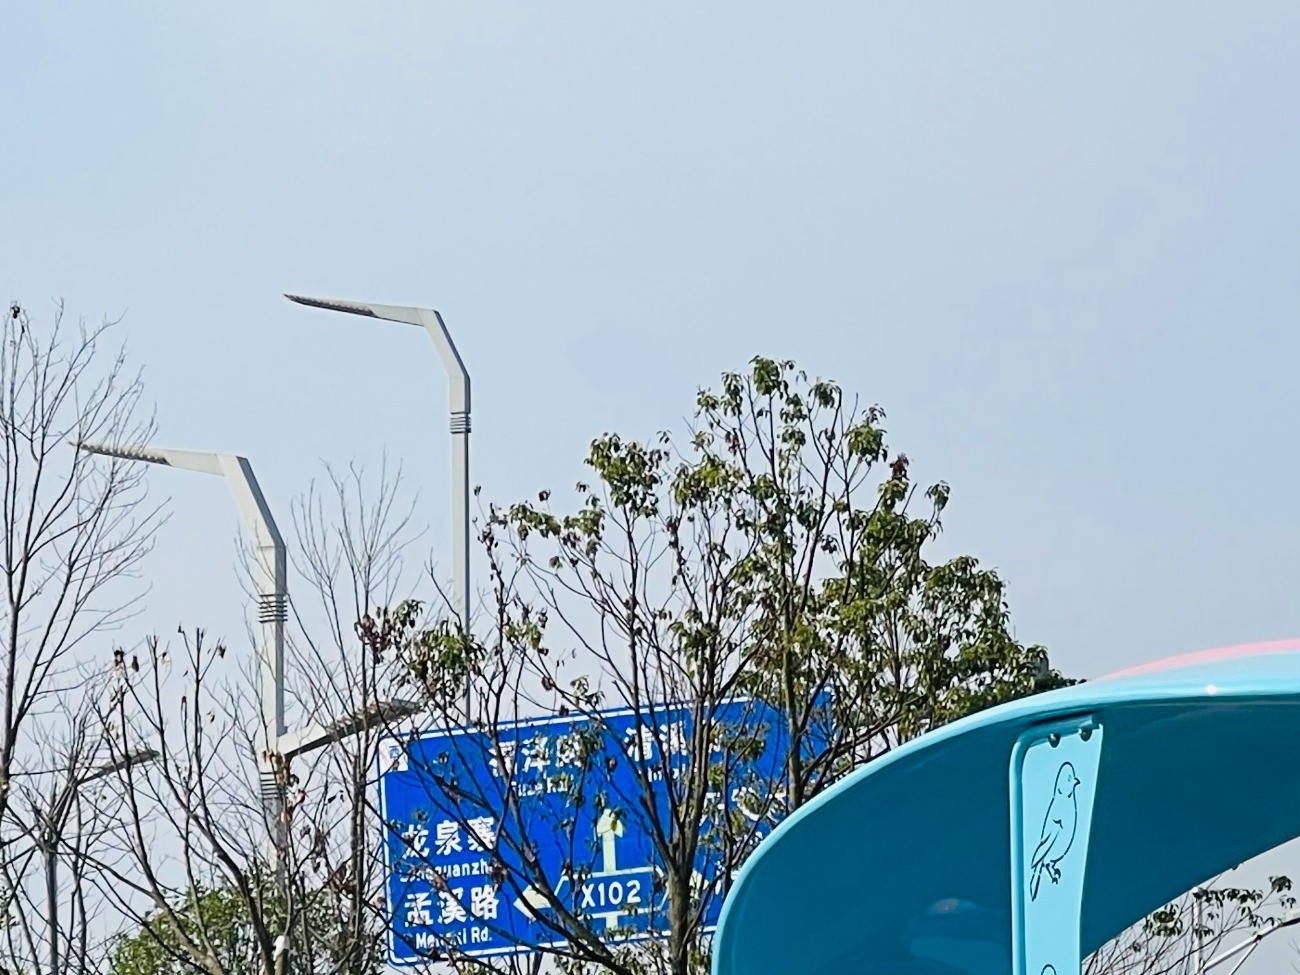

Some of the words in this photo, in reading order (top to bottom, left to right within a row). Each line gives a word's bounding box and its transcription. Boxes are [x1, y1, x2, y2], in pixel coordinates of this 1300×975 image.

[404, 884, 499, 927] 孟溪路
[581, 879, 641, 908] X102
[471, 926, 492, 944] Rd.
